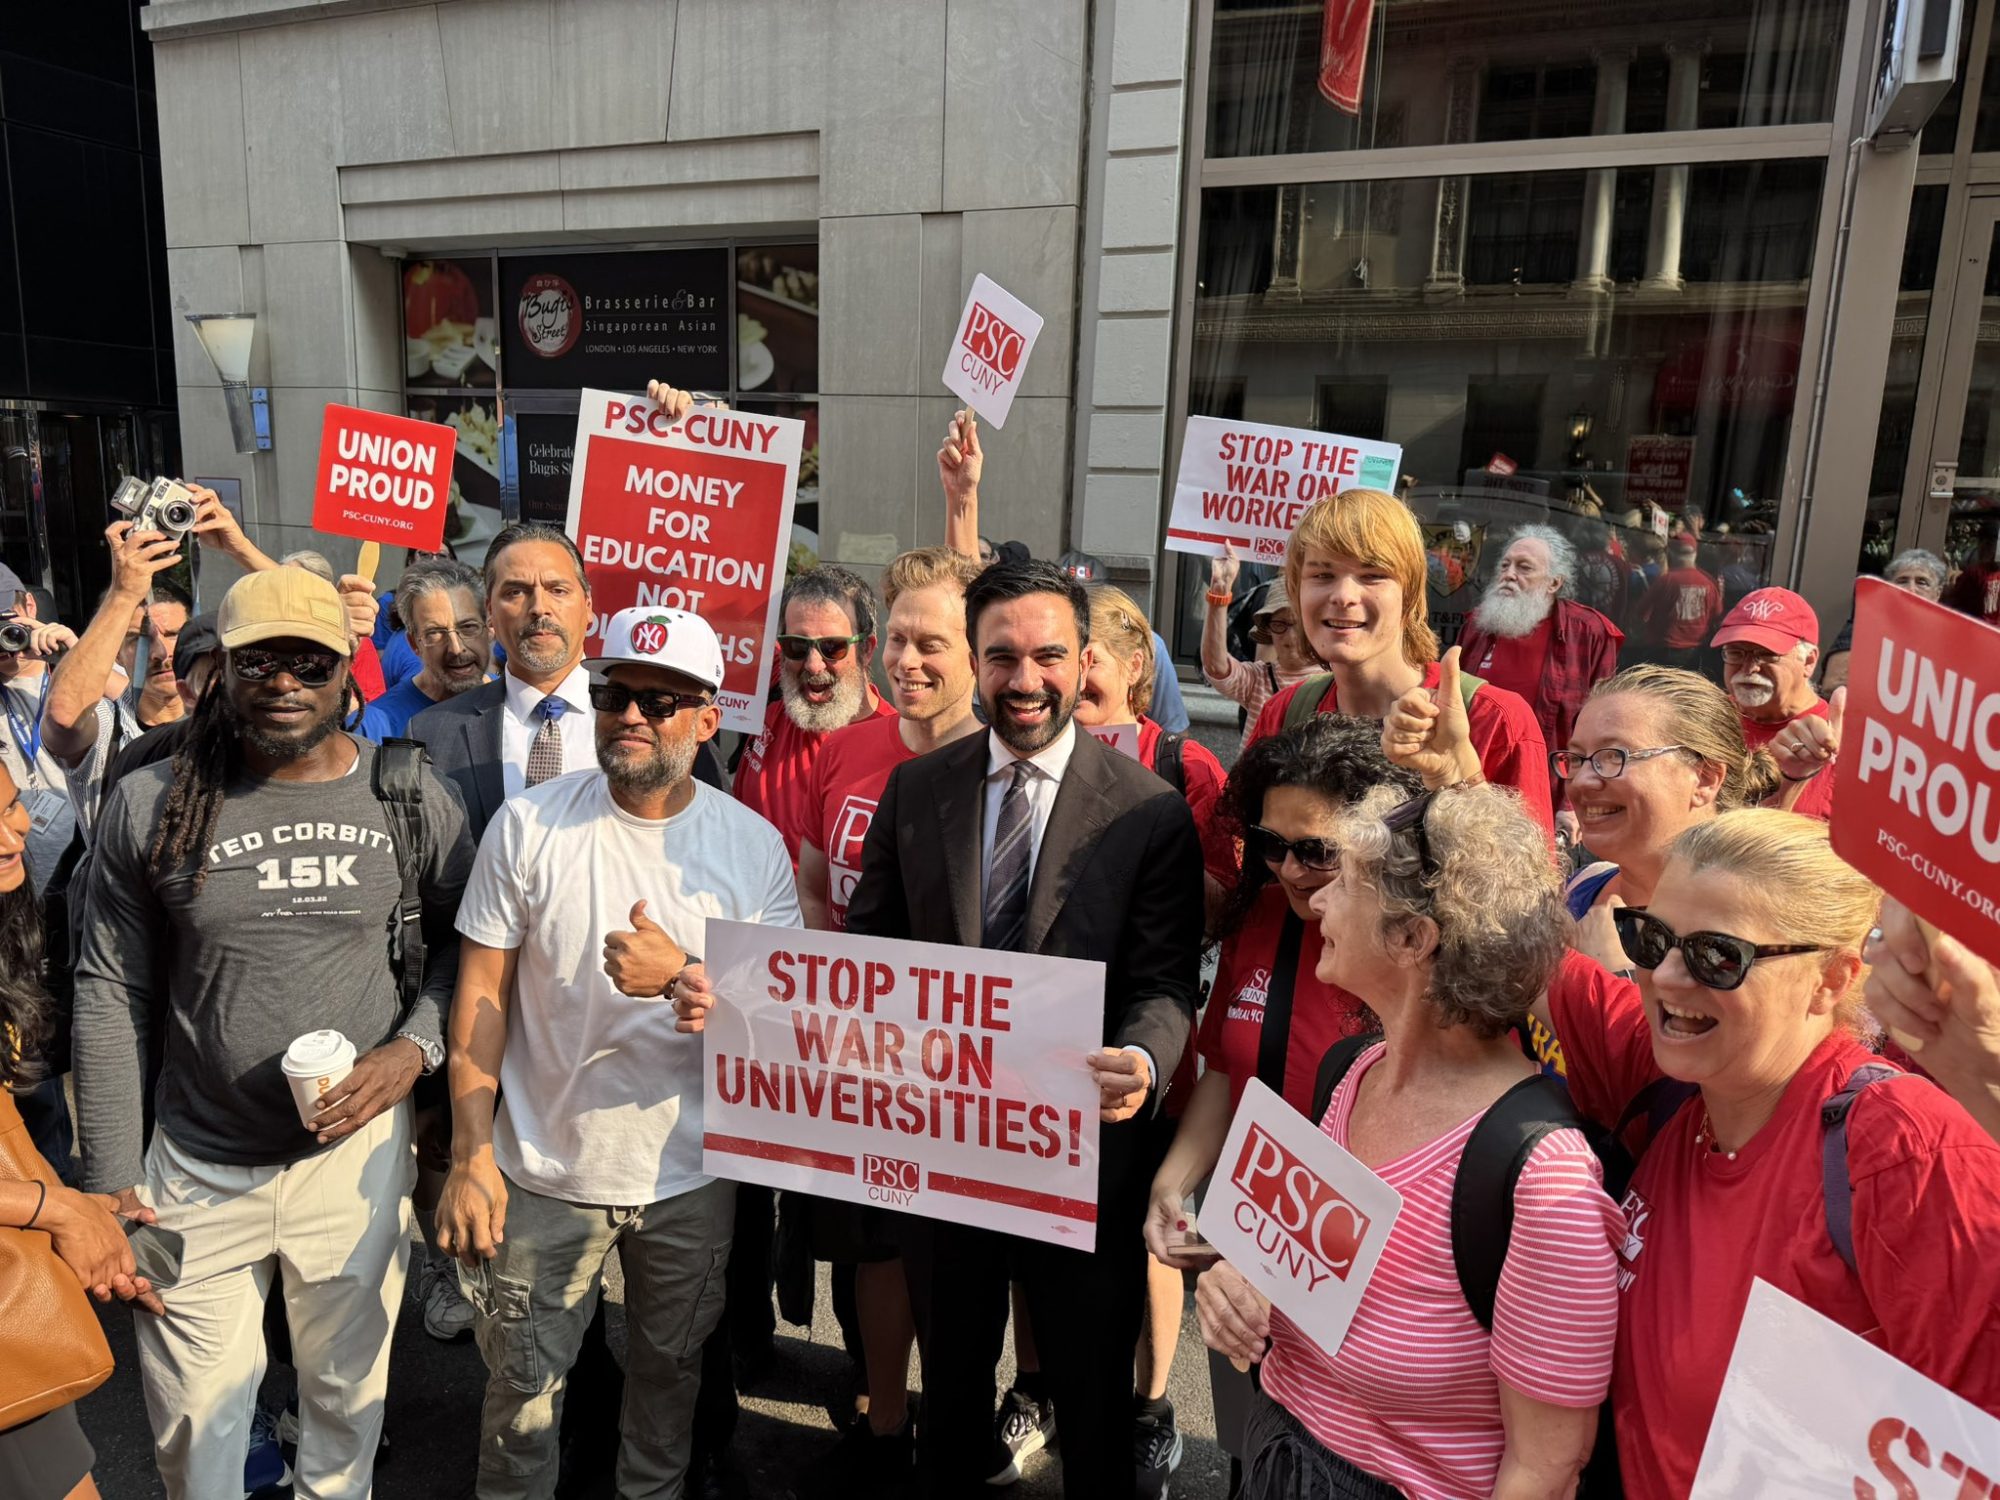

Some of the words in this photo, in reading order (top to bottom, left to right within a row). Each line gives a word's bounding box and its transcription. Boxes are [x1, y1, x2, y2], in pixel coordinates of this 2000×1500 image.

[584, 295, 669, 310] Brasserie
[687, 293, 716, 309] Bar
[532, 324, 566, 344] Street
[584, 321, 669, 334] Singaporean
[678, 320, 717, 332] Asian
[963, 304, 1024, 376] PSC
[585, 345, 616, 354] LONDON
[623, 345, 637, 354] LOS
[638, 345, 671, 354] ANGELES
[677, 345, 695, 354] NEW
[696, 345, 718, 354] YORK
[961, 352, 1004, 396] CUNY
[604, 400, 779, 453] PSC-CUNY
[338, 428, 437, 475] UNION
[529, 460, 560, 477] Bugis
[1218, 432, 1294, 467] STOP
[1301, 442, 1360, 476] THE
[329, 463, 434, 511] PROUD
[624, 465, 744, 508] MONEY
[1226, 464, 1290, 499] WAR
[1297, 473, 1340, 502] ON
[342, 510, 414, 531] PSC-CUNY.ORG
[648, 507, 710, 544] FOR
[1202, 491, 1305, 530] WORKE
[583, 534, 764, 591] EDUCATION
[1255, 537, 1287, 554] PSC
[1255, 552, 1280, 562] CUNY
[636, 581, 705, 613] NOT
[635, 622, 663, 651] NY
[208, 831, 265, 864] TED
[272, 822, 394, 854] CORBITT
[256, 854, 360, 890] 15K
[767, 950, 896, 1013] STOP
[908, 966, 1013, 1032] THE
[791, 1010, 905, 1076] WAR
[921, 1027, 993, 1089] ON
[716, 1053, 1082, 1167] UNIVERSITIES!
[864, 1155, 918, 1191] PSC
[868, 1187, 914, 1206] CUNY
[1235, 1127, 1364, 1268] PSC
[1234, 1201, 1331, 1293] CUNY
